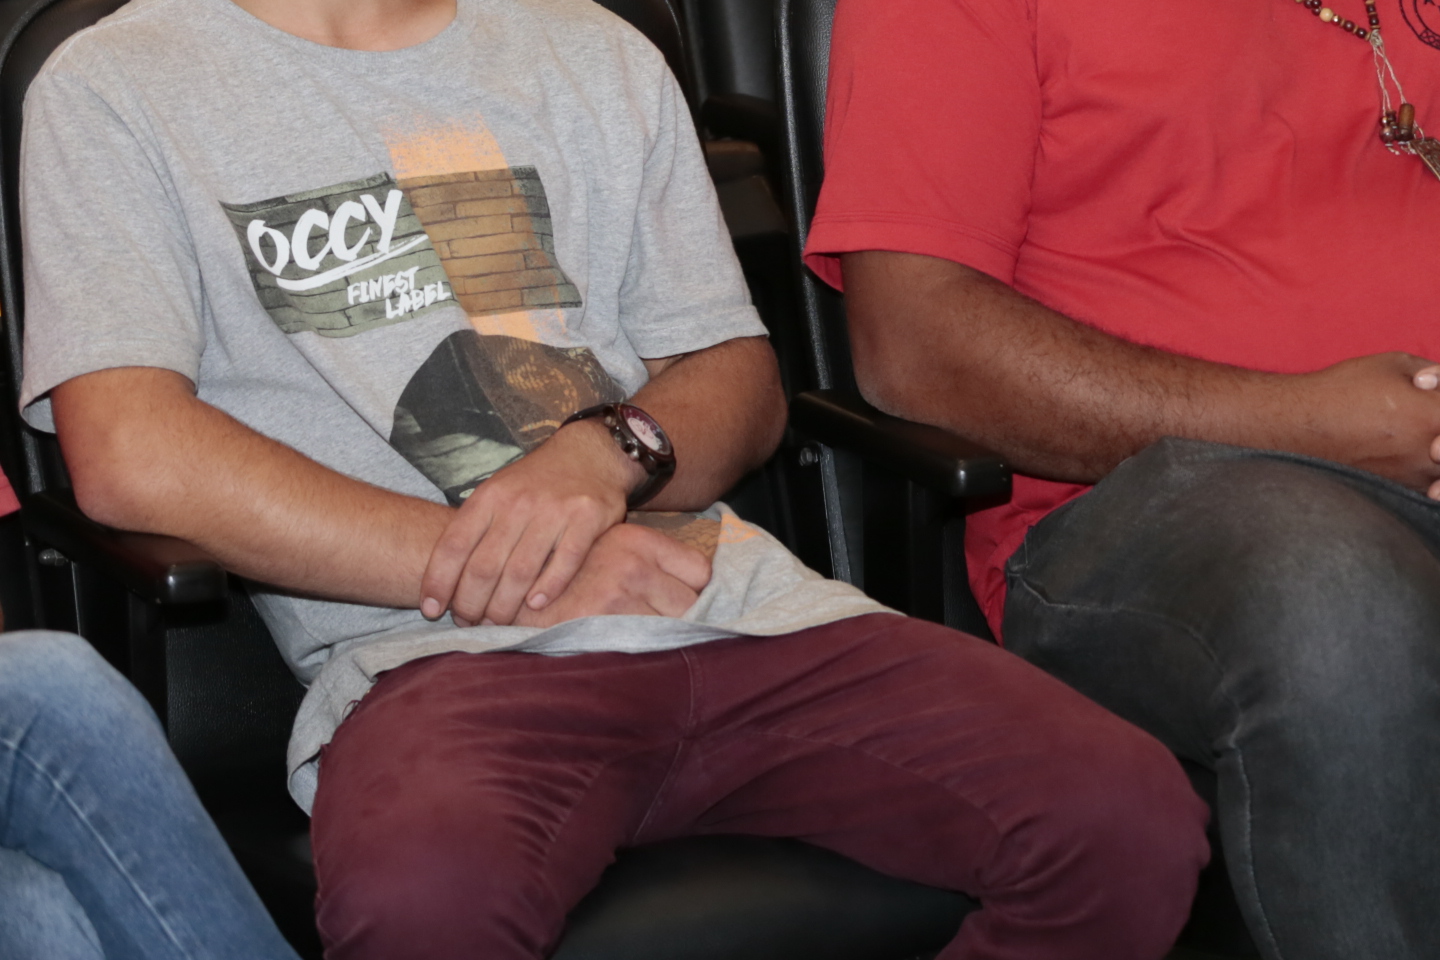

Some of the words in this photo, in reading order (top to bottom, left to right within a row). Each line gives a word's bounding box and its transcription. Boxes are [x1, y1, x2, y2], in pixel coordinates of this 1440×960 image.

[247, 189, 403, 276] OCCY
[347, 266, 419, 305] FINEST
[385, 281, 451, 319] LABEL
